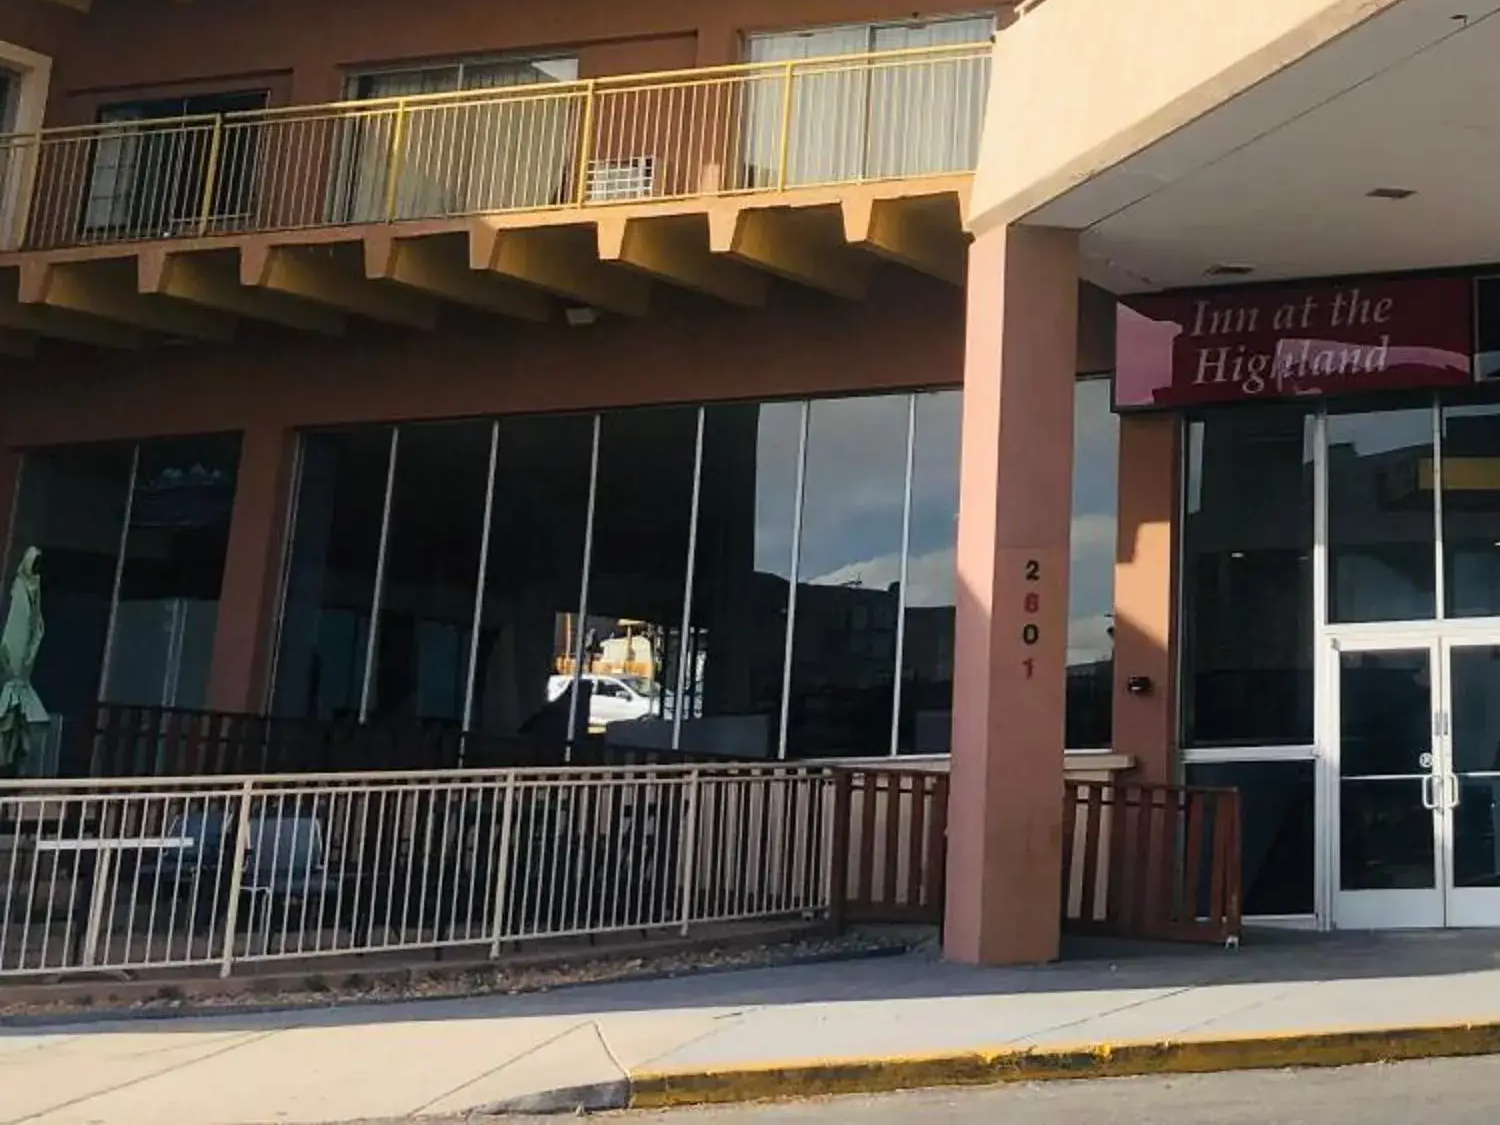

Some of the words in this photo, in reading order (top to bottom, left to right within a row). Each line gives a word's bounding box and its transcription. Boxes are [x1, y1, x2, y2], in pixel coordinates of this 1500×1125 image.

[1190, 300, 1259, 337] Inn
[1273, 295, 1318, 330] at
[1330, 288, 1394, 327] the
[1193, 333, 1391, 395] Highland
[1021, 559, 1041, 680] 2601
